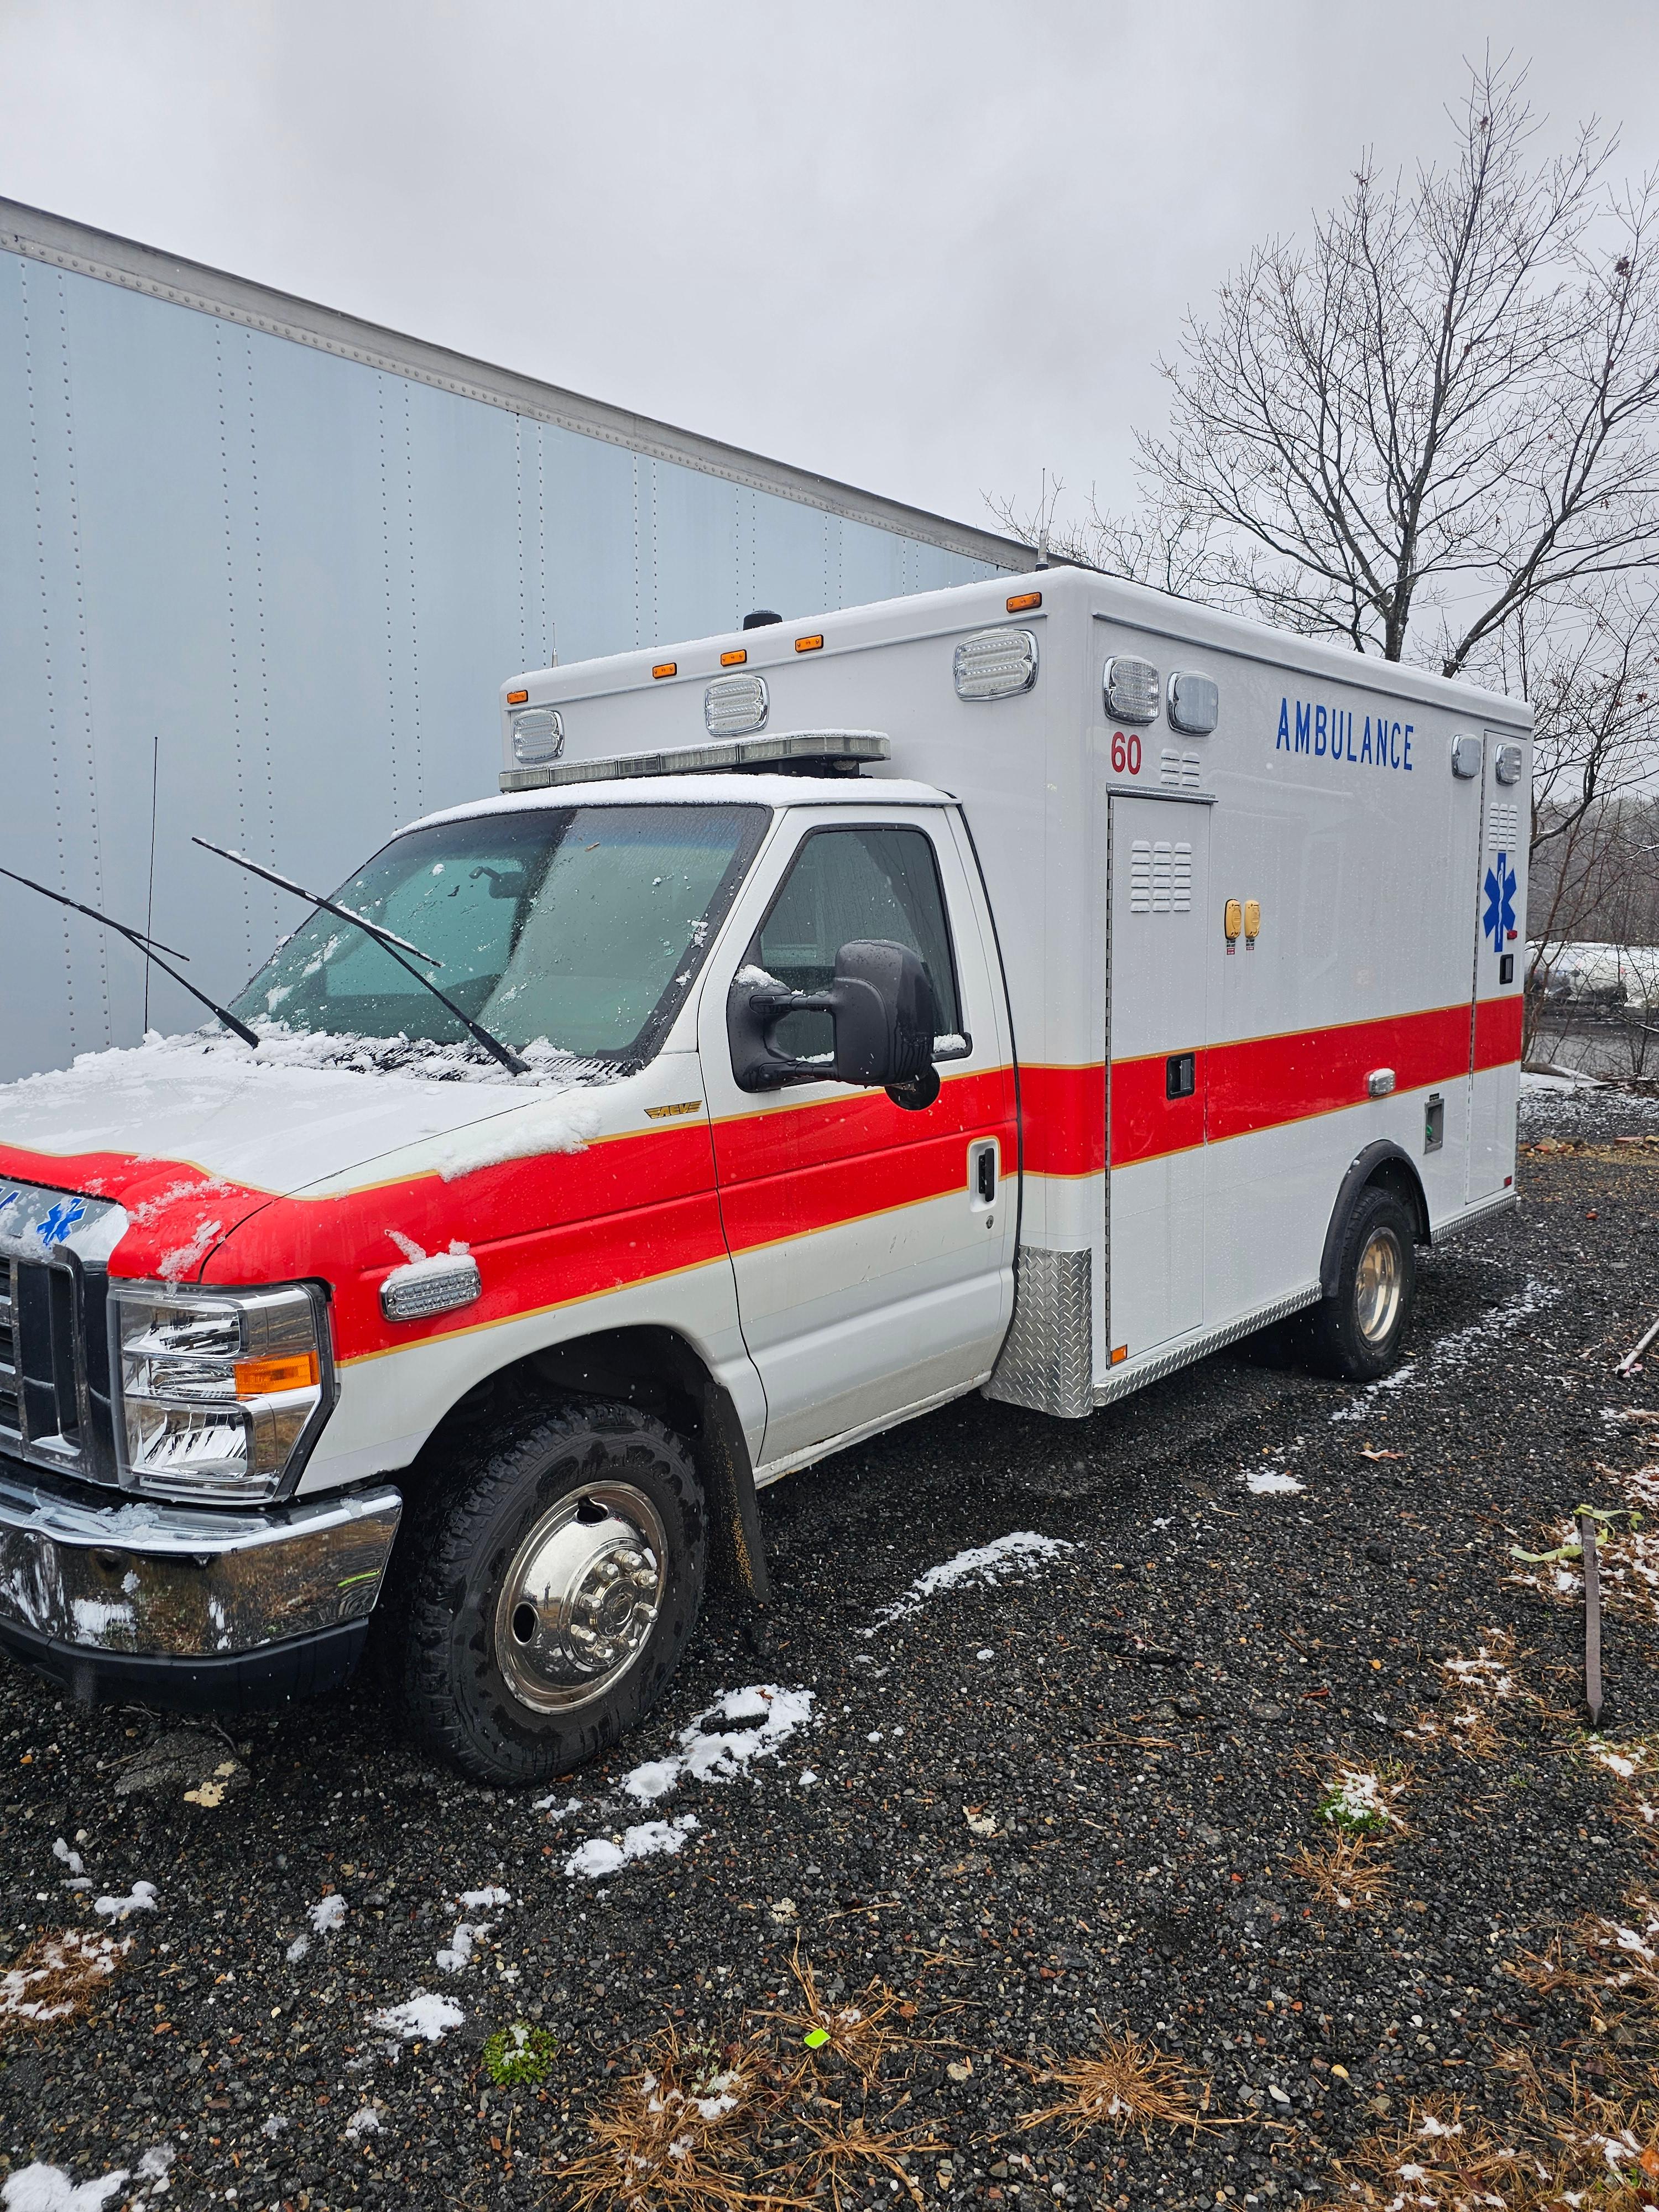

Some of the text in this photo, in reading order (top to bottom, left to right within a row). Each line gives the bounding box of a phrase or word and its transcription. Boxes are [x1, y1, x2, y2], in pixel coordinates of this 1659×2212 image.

[1112, 732, 1141, 774] 60
[1276, 698, 1413, 770] AMBULANCE
[657, 1102, 691, 1117] AEV
